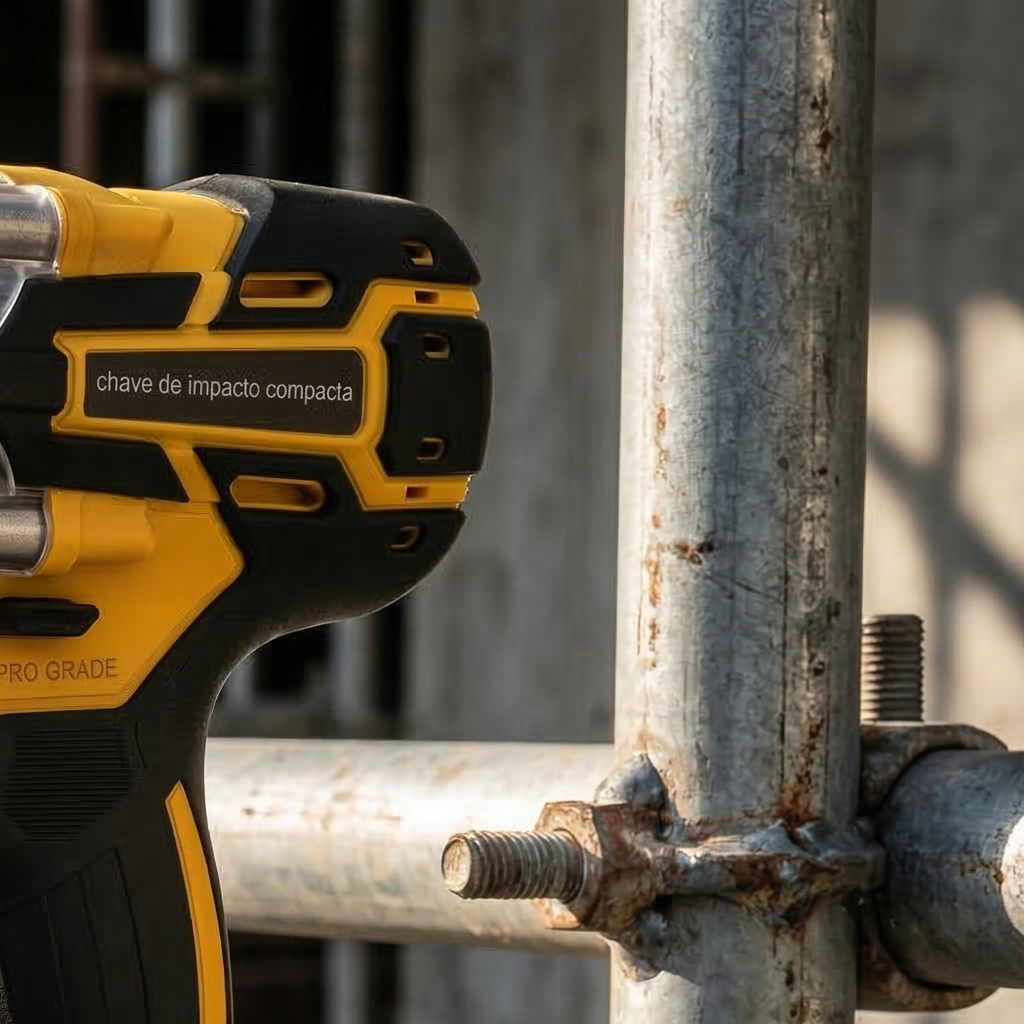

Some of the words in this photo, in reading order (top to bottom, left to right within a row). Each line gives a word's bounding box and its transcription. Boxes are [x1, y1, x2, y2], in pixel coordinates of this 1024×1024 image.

[96, 370, 153, 394] chave
[159, 373, 182, 395] de
[188, 374, 260, 401] impacto
[265, 382, 353, 405] compacta
[45, 658, 117, 682] GRADE
